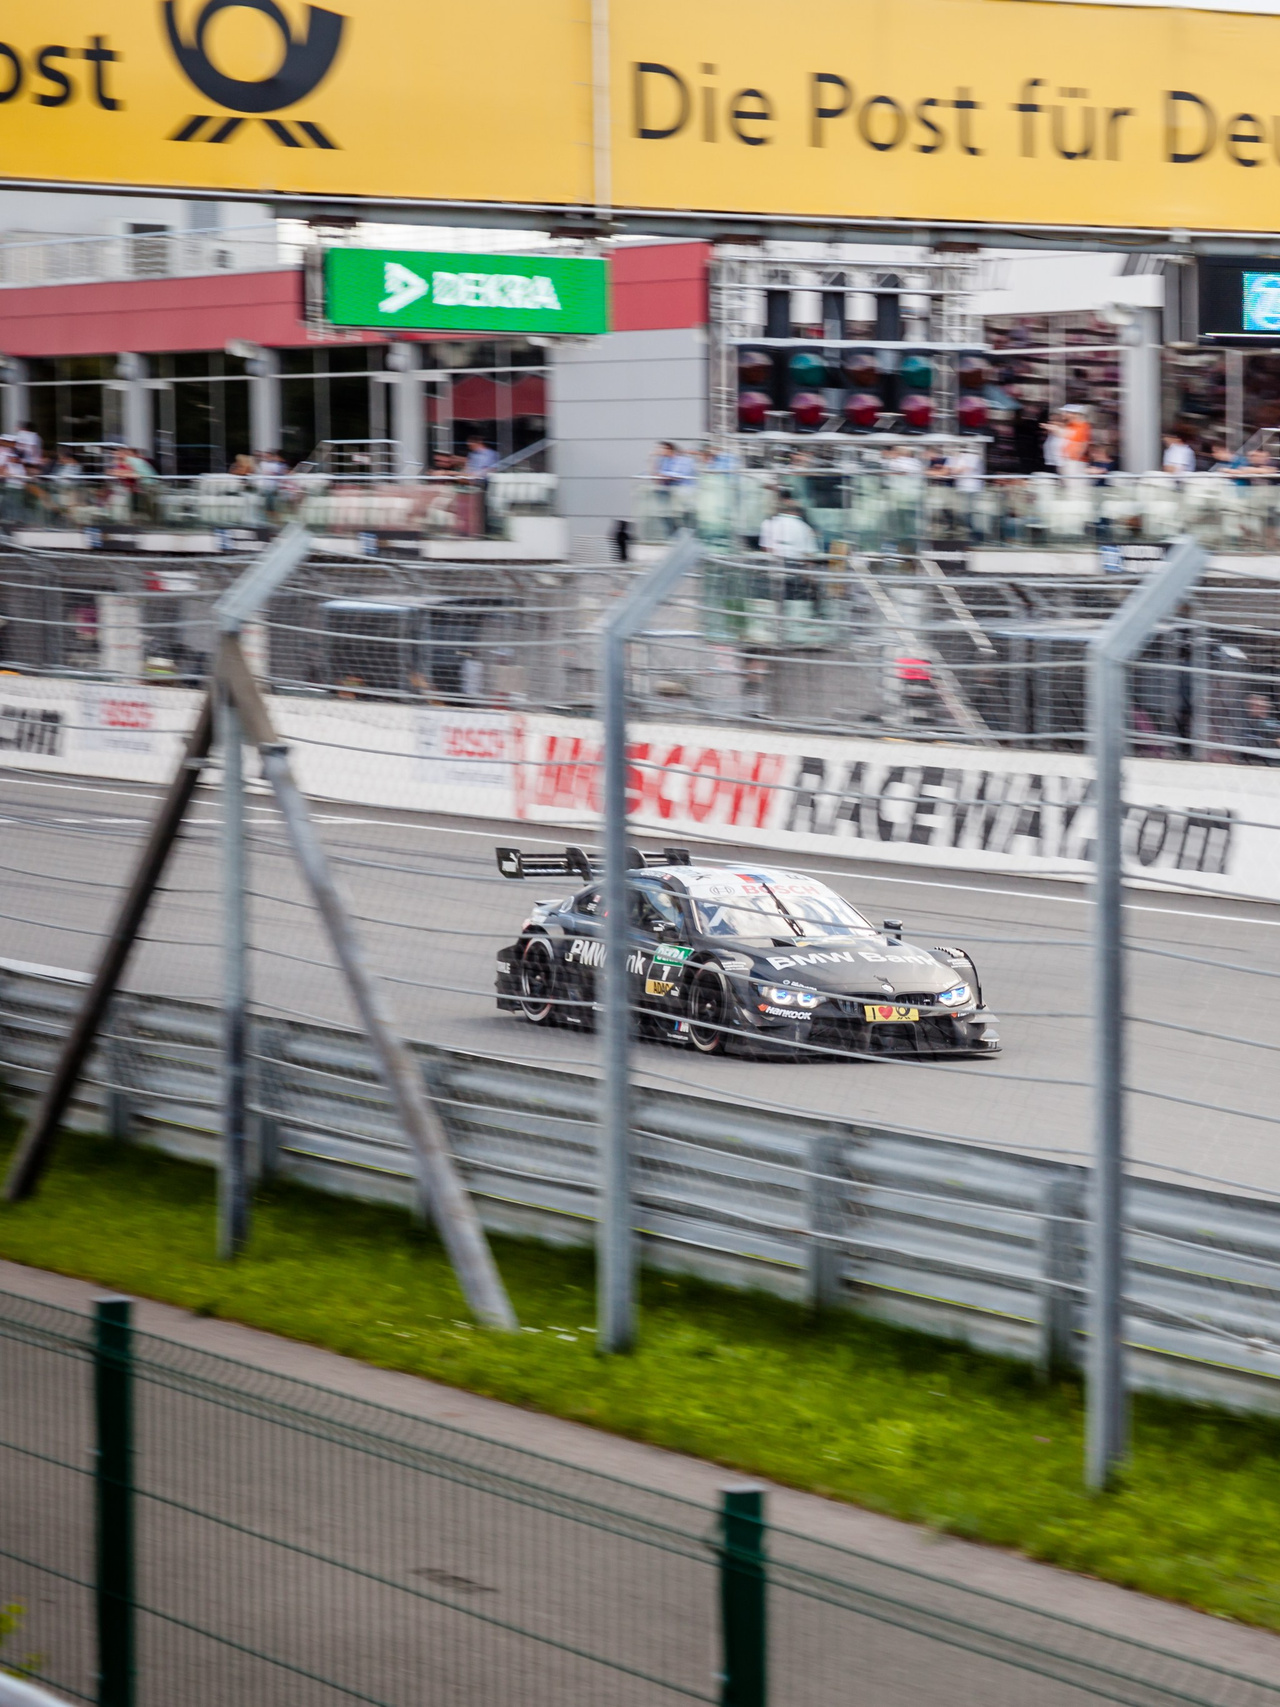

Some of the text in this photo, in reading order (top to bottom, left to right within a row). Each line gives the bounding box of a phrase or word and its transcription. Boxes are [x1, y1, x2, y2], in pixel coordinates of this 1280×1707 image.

[631, 62, 777, 147] Die
[809, 72, 985, 158] Post
[1011, 78, 1137, 161] für
[432, 271, 562, 311] DEKRA
[741, 885, 821, 895] BOSCH
[626, 950, 646, 976] nk
[766, 950, 854, 970] BMW
[858, 951, 943, 969] Bank
